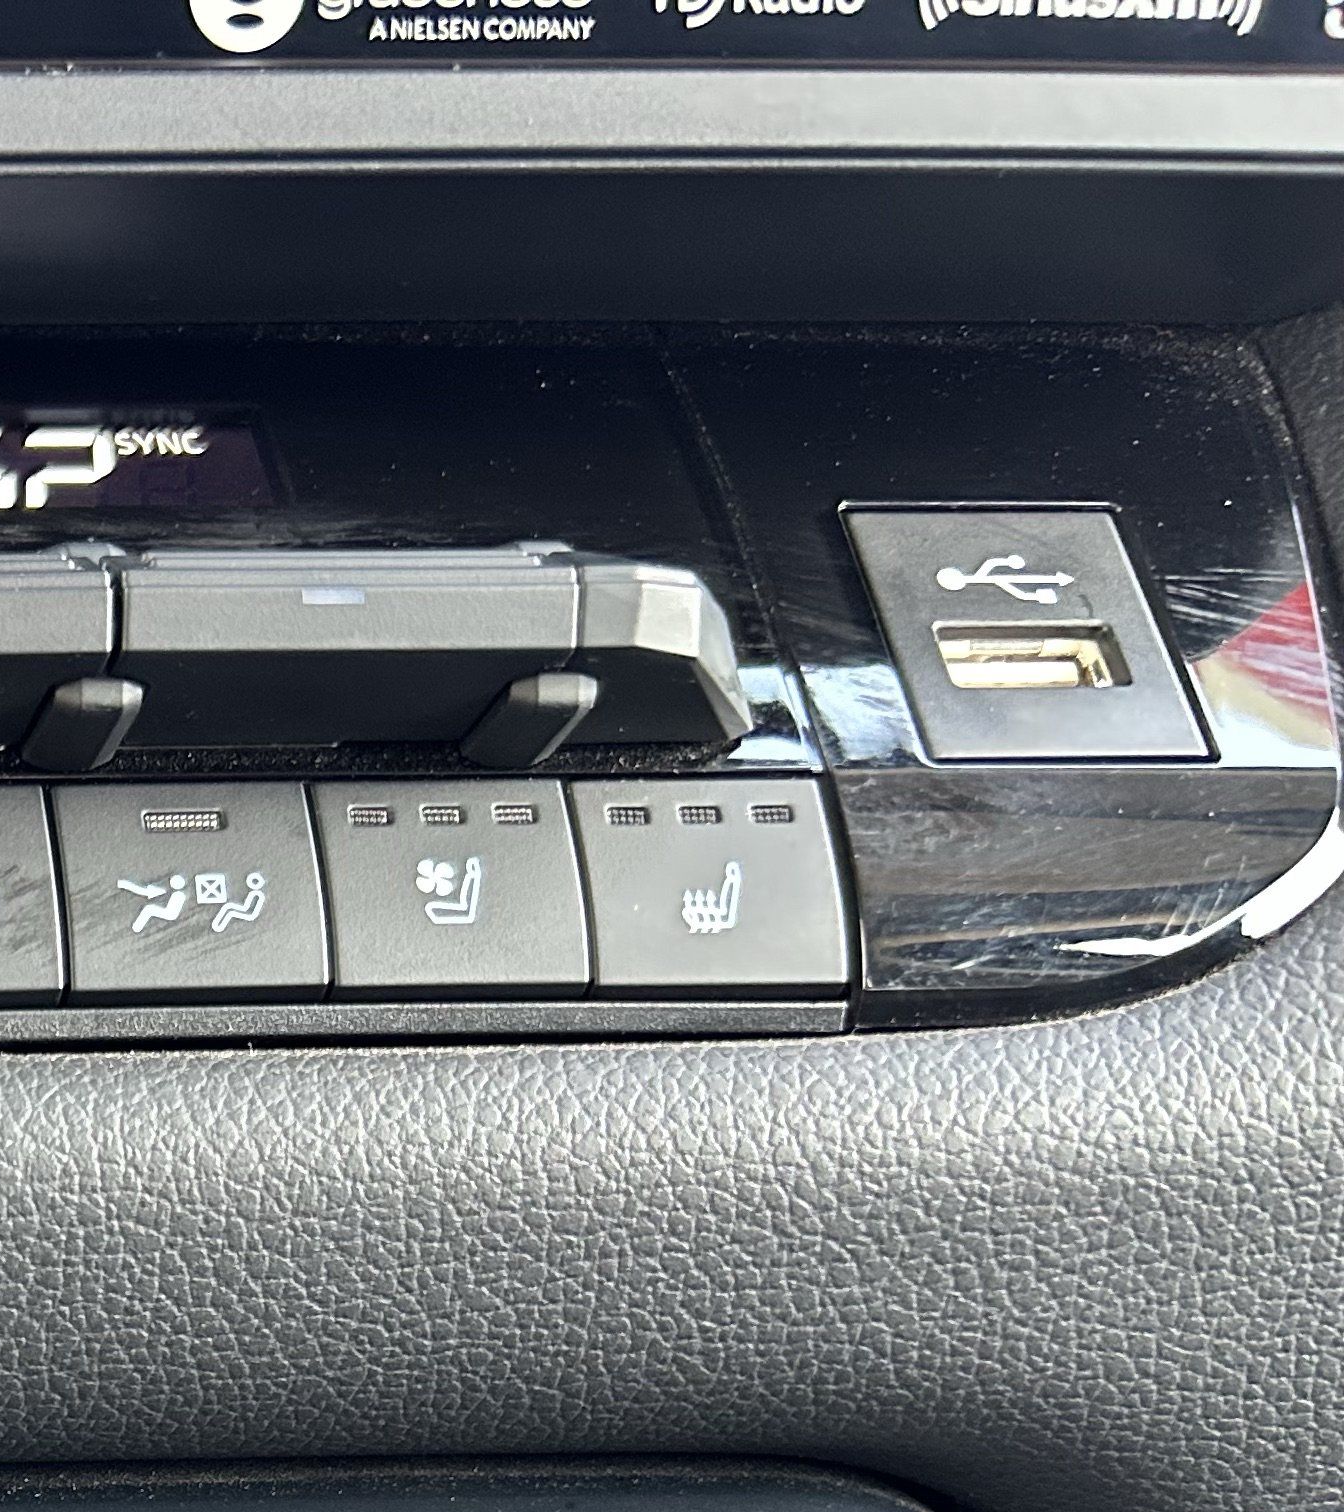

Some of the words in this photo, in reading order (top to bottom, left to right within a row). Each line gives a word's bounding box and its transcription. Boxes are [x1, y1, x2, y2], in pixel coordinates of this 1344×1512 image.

[369, 17, 388, 41] A
[390, 16, 480, 41] NIELSEN
[483, 16, 596, 41] COMPANY
[114, 426, 208, 456] SYNC
